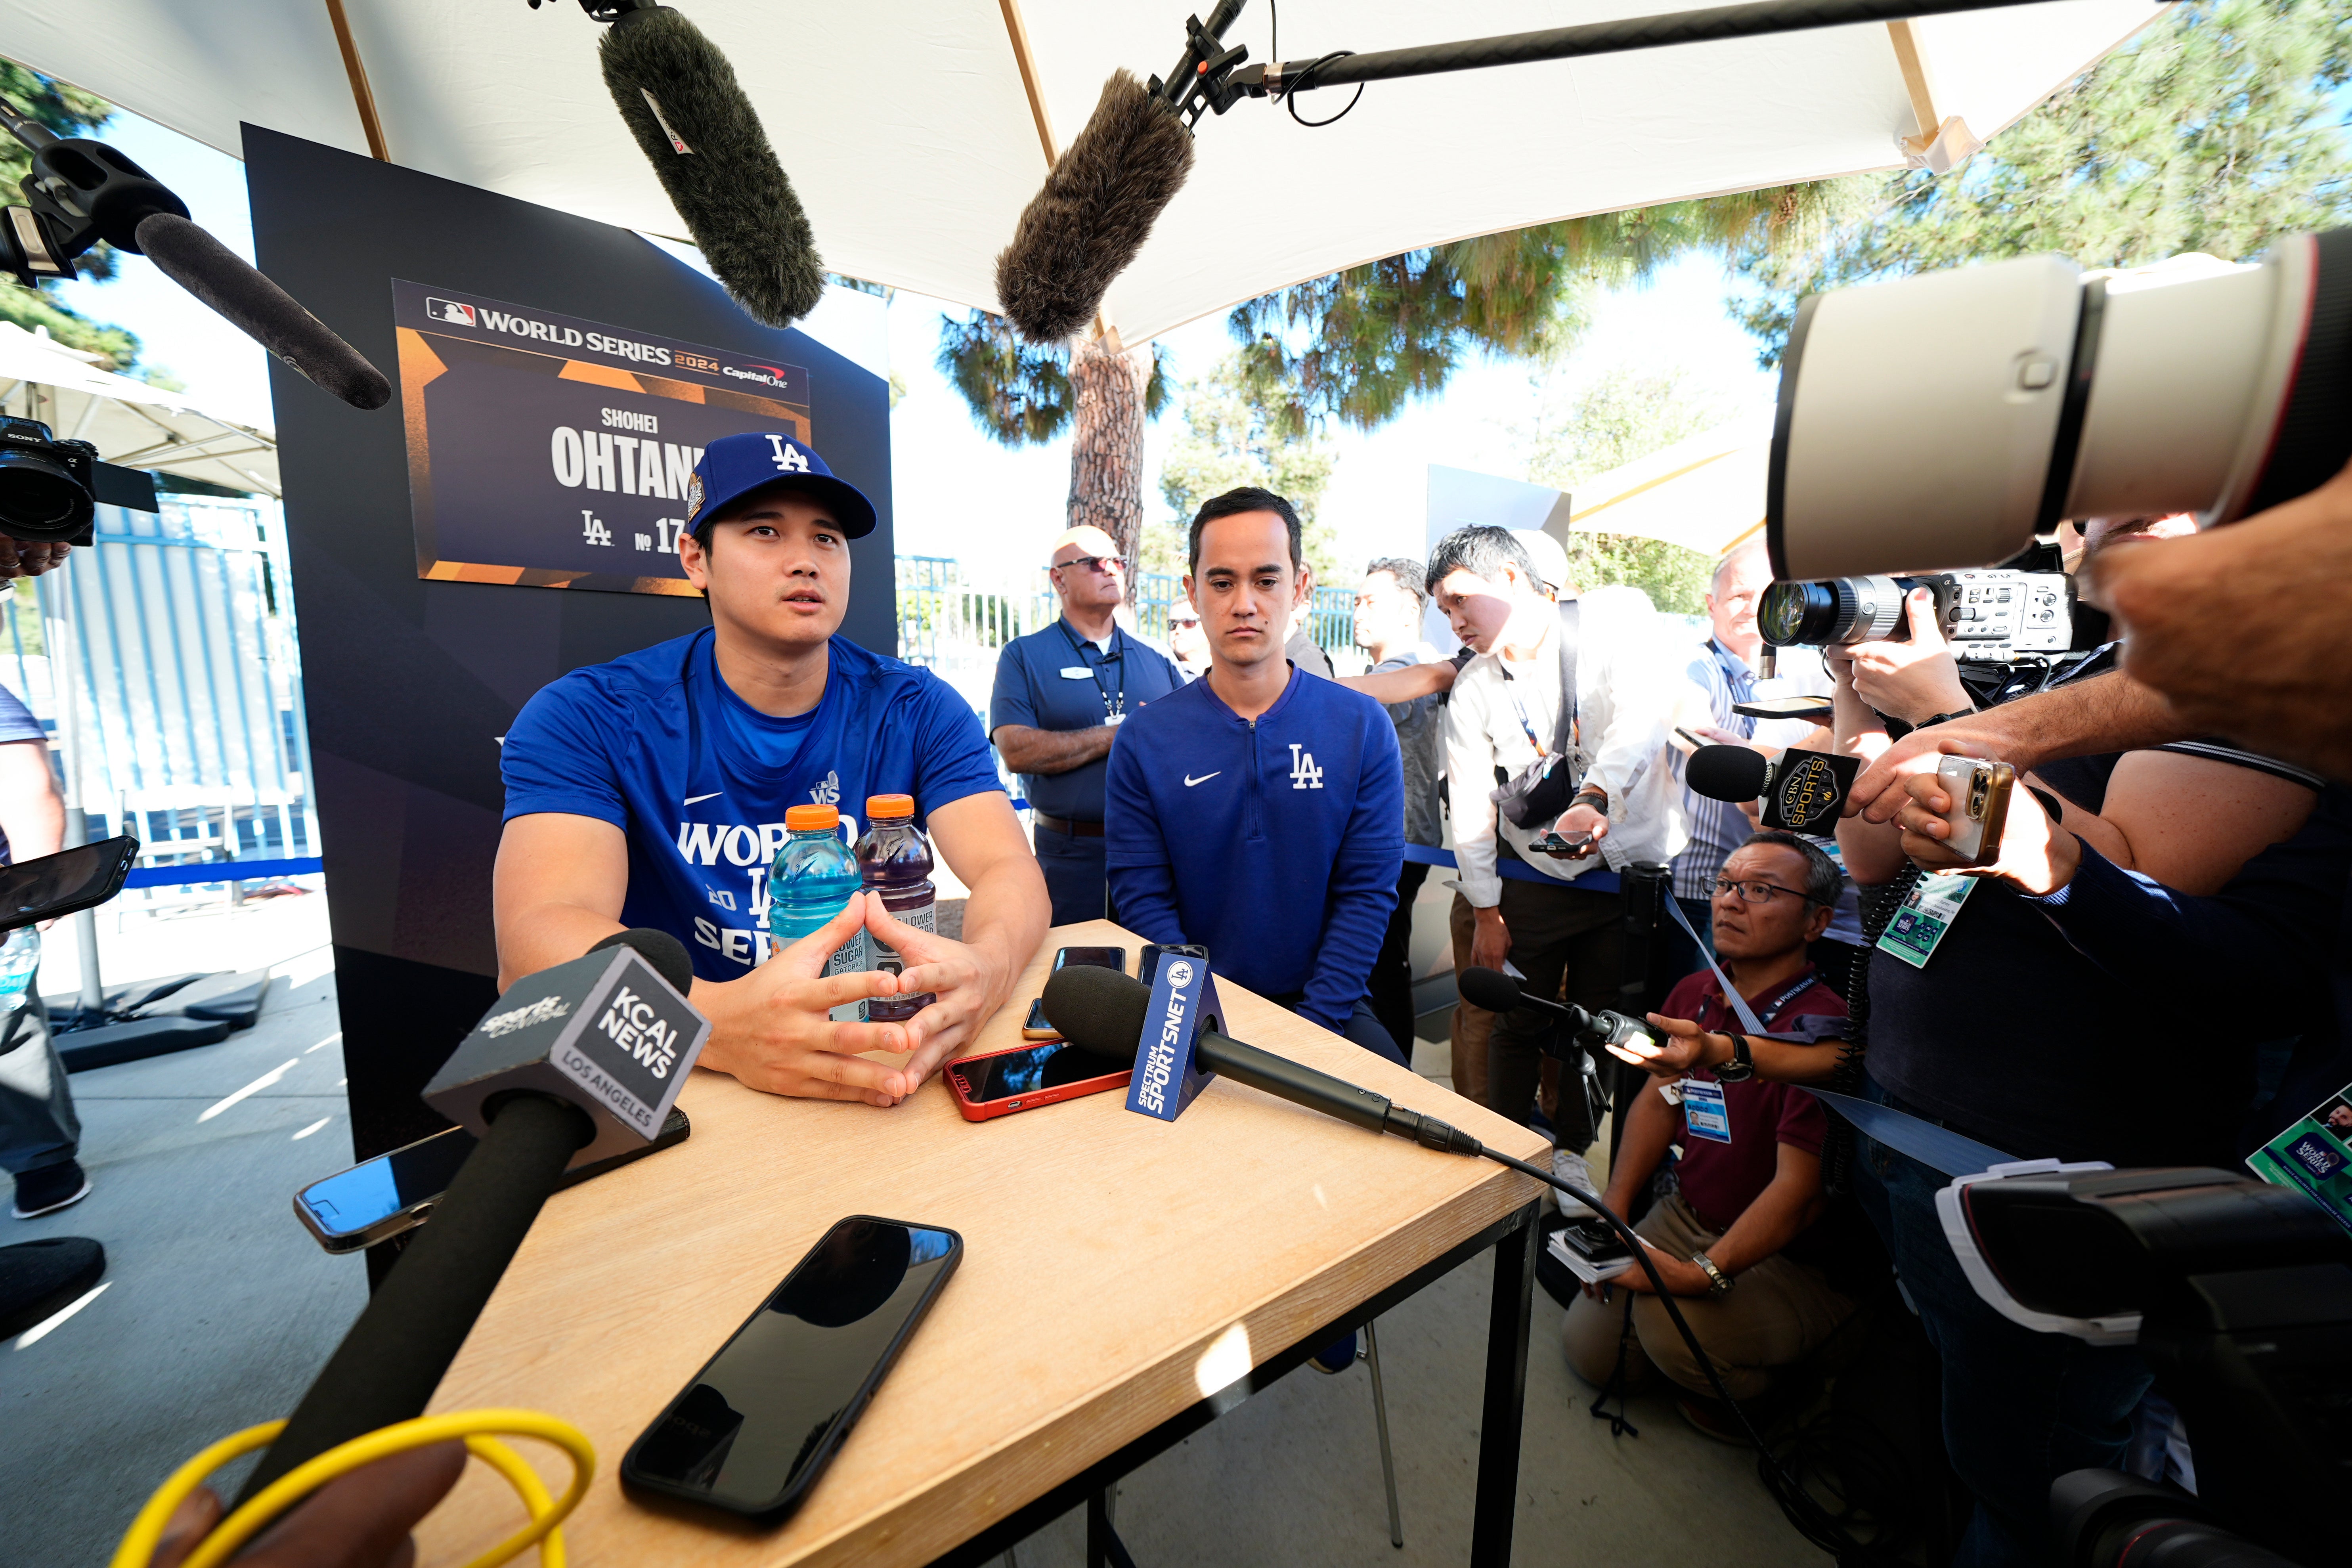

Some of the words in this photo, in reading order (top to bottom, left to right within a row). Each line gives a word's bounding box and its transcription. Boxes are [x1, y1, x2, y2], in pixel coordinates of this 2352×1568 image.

[478, 308, 583, 347] WORLD
[586, 332, 672, 366] SERIES
[675, 354, 719, 371] 2024
[8, 433, 42, 442] SONY
[601, 407, 658, 434] SHOHEI
[765, 434, 811, 472] LA
[581, 510, 612, 547] LA
[656, 517, 685, 555] 17
[1289, 744, 1323, 789] LA
[809, 786, 840, 805] WS
[1785, 776, 1801, 804] CBN
[1792, 760, 1824, 824] SPORTS
[834, 945, 862, 966] SUGAR
[1171, 968, 1188, 980] LA
[1779, 977, 1815, 1002] POSTSEASON
[612, 986, 677, 1059] KCAL
[598, 1008, 672, 1079] NEWS
[1147, 988, 1187, 1115] SPORTSNET
[562, 1050, 591, 1079] LOS
[589, 1070, 653, 1127] ANGELES
[1138, 1046, 1158, 1107] SPECTRUM
[2296, 1147, 2328, 1174] SERIES
[2301, 1141, 2331, 1168] WORLD
[2293, 1175, 2311, 1191] REQUIRED
[2316, 1196, 2337, 1216] CLUBHOUSE
[2336, 1214, 2352, 1228] ACCESS
